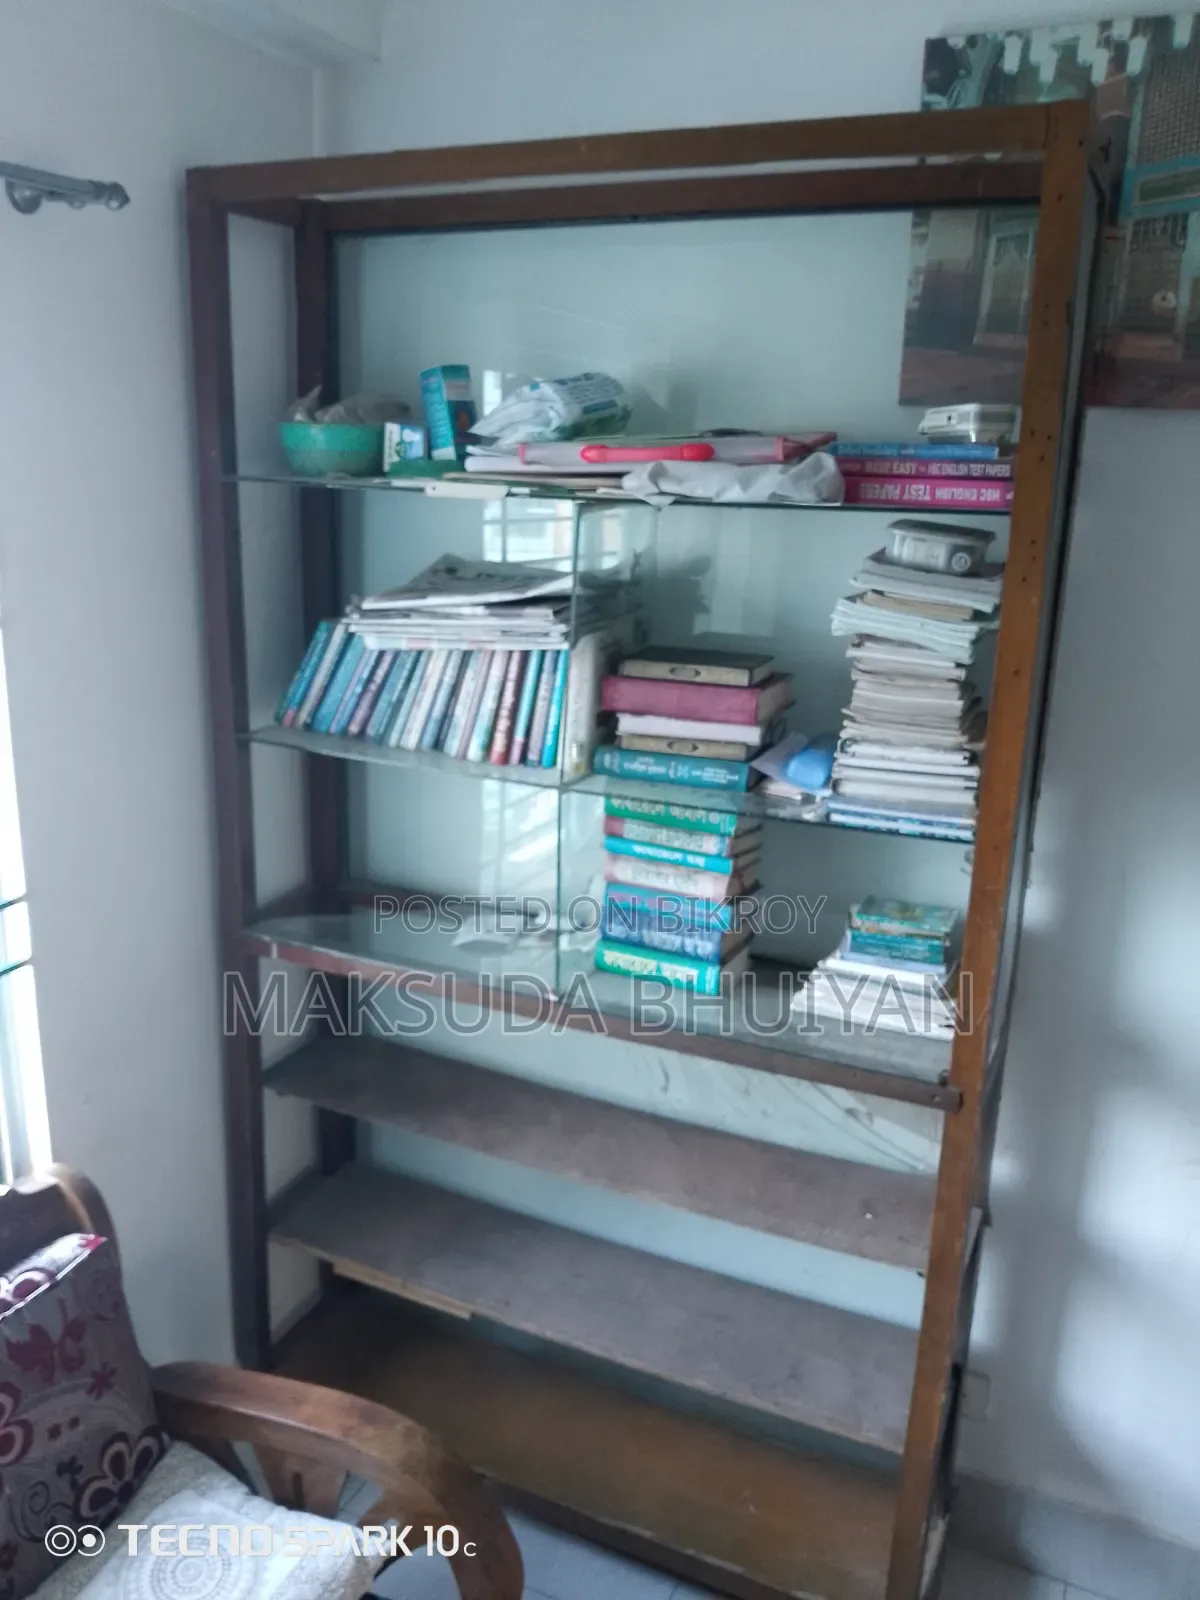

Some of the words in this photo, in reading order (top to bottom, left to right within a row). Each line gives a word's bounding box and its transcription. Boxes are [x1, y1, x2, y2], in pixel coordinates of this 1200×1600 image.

[902, 484, 931, 501] TEST
[934, 486, 978, 501] ENGLISH
[979, 488, 1001, 502] HSC
